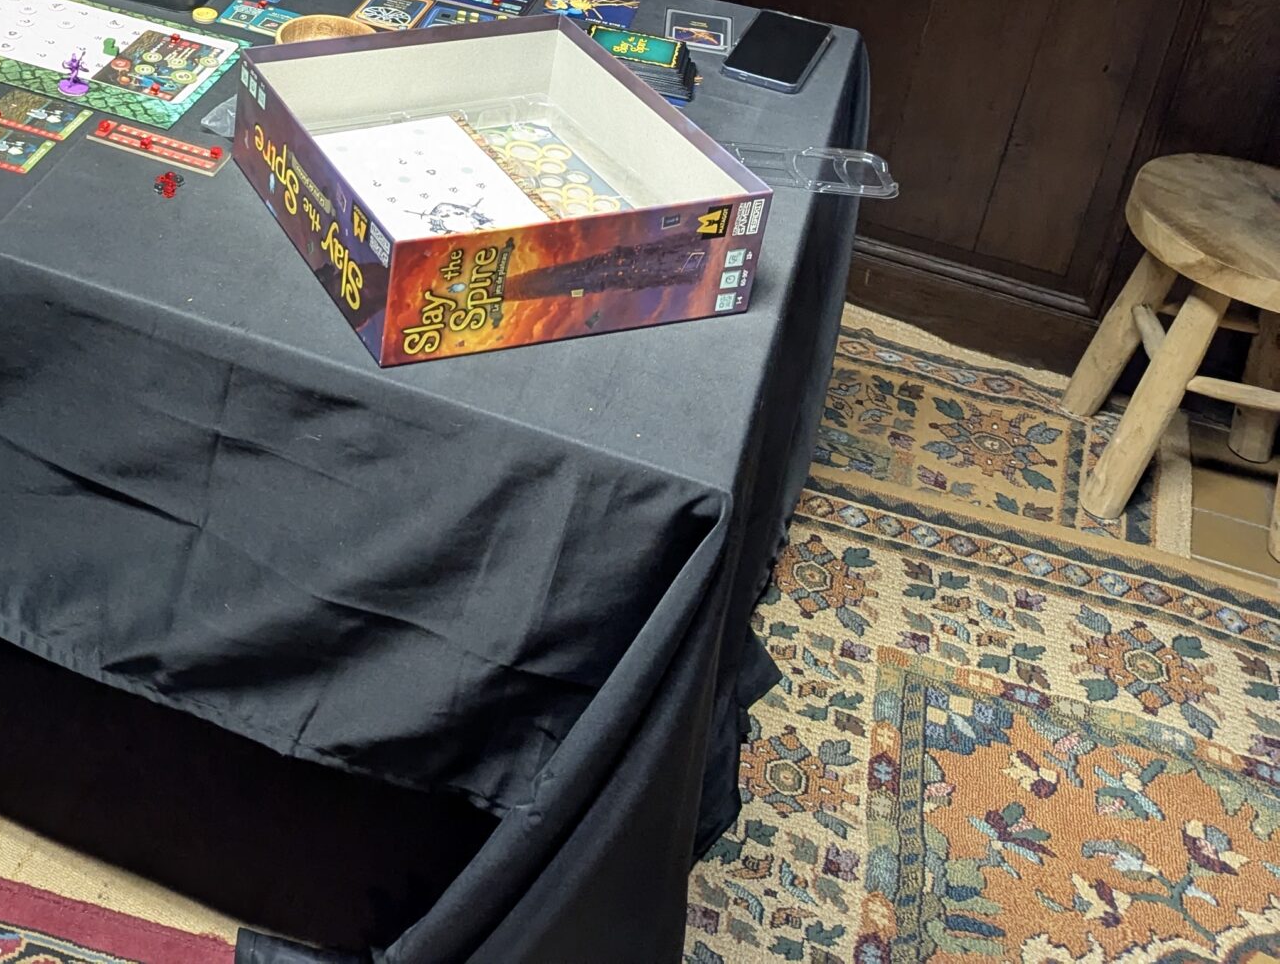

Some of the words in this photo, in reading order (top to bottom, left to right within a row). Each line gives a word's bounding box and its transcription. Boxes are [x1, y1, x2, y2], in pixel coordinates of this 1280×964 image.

[254, 124, 300, 216] Spire
[303, 196, 321, 232] the
[718, 207, 729, 234] MATAGOT
[737, 202, 752, 235] GAMES
[320, 222, 364, 310] Slay
[403, 291, 458, 355] Slay
[441, 249, 463, 280] the
[449, 247, 502, 331] Spire
